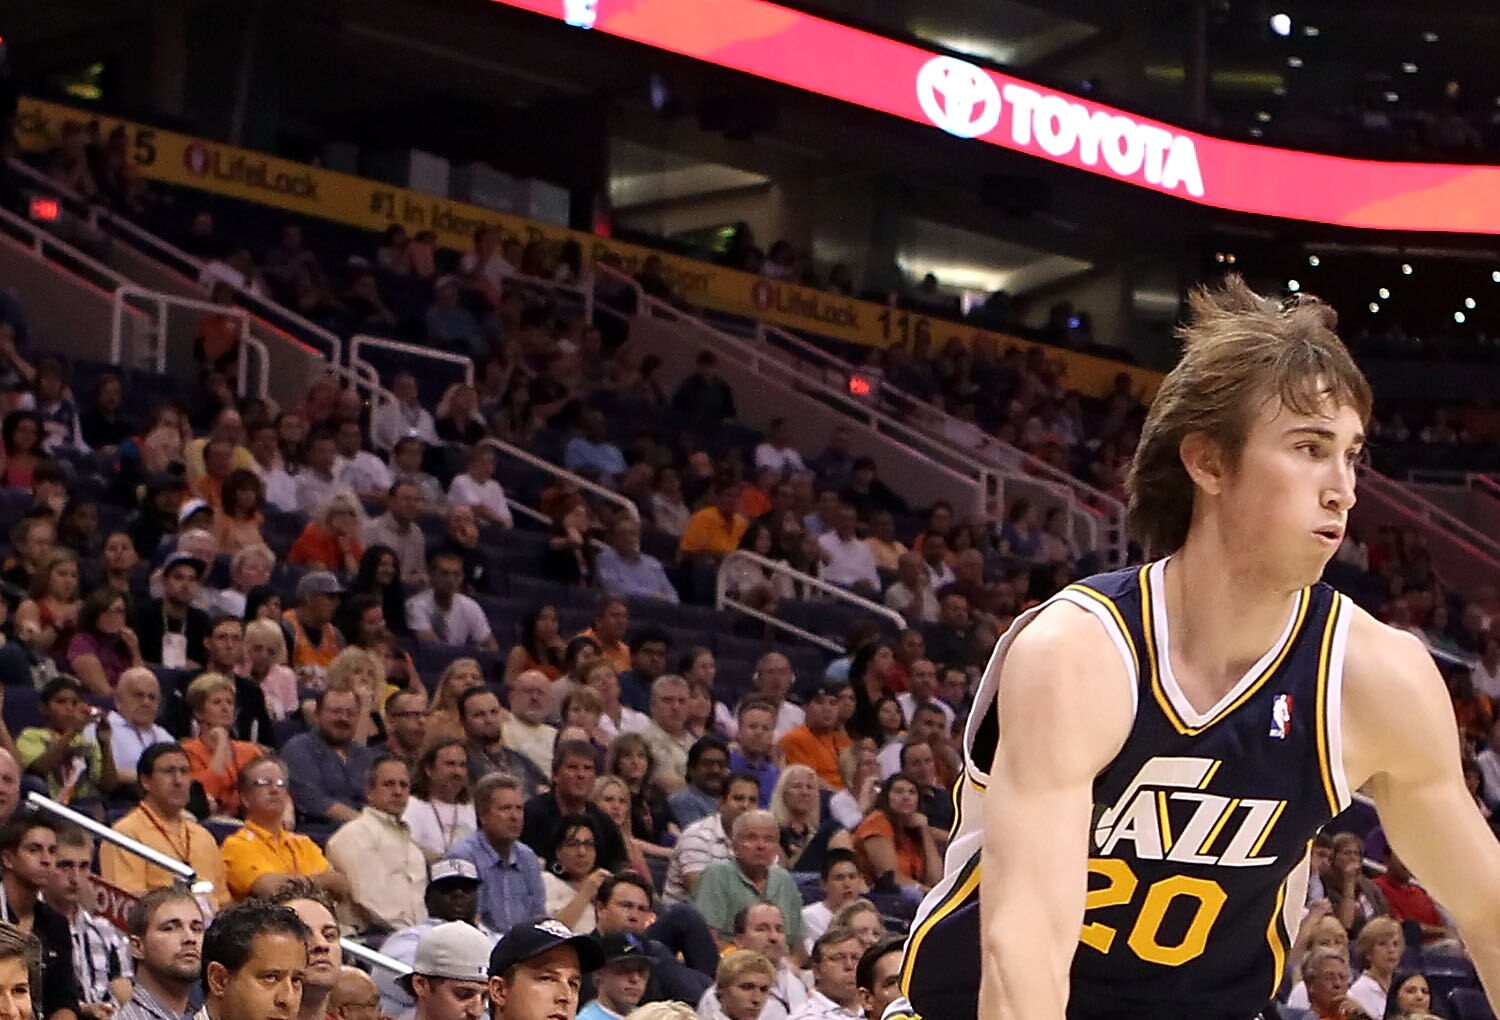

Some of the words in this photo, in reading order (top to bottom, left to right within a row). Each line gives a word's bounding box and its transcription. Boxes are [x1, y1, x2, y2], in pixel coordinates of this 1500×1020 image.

[1003, 83, 1205, 198] TOYOTA
[1096, 756, 1288, 867] JAZZ
[1078, 858, 1228, 967] 20
